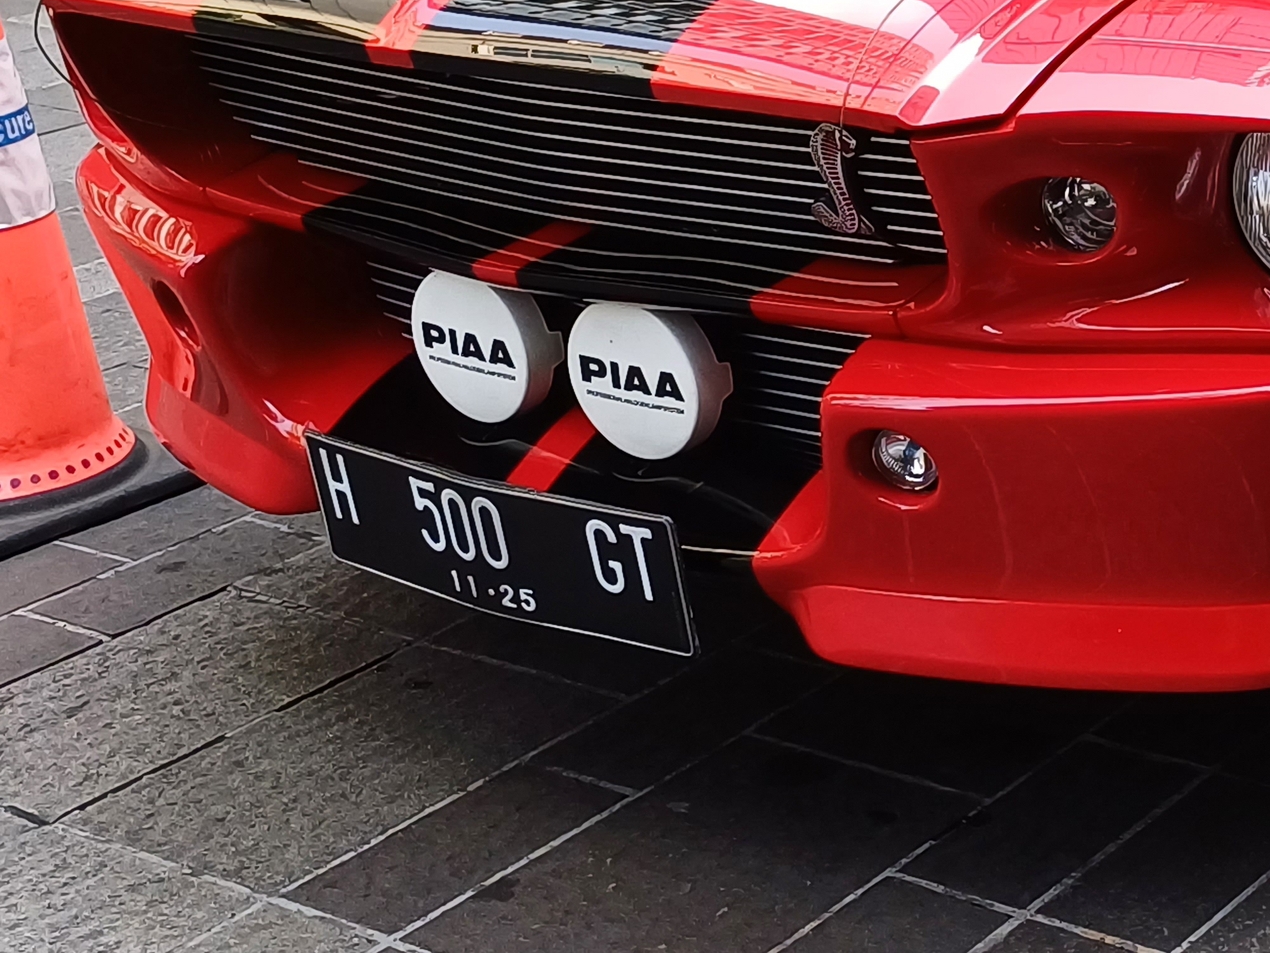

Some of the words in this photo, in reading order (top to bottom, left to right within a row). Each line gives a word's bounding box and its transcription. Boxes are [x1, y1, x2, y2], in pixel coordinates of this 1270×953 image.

[421, 321, 517, 370] PIAA
[578, 354, 686, 403] PIAA
[318, 447, 360, 525] H
[408, 475, 510, 570] 500
[585, 518, 654, 601] GT
